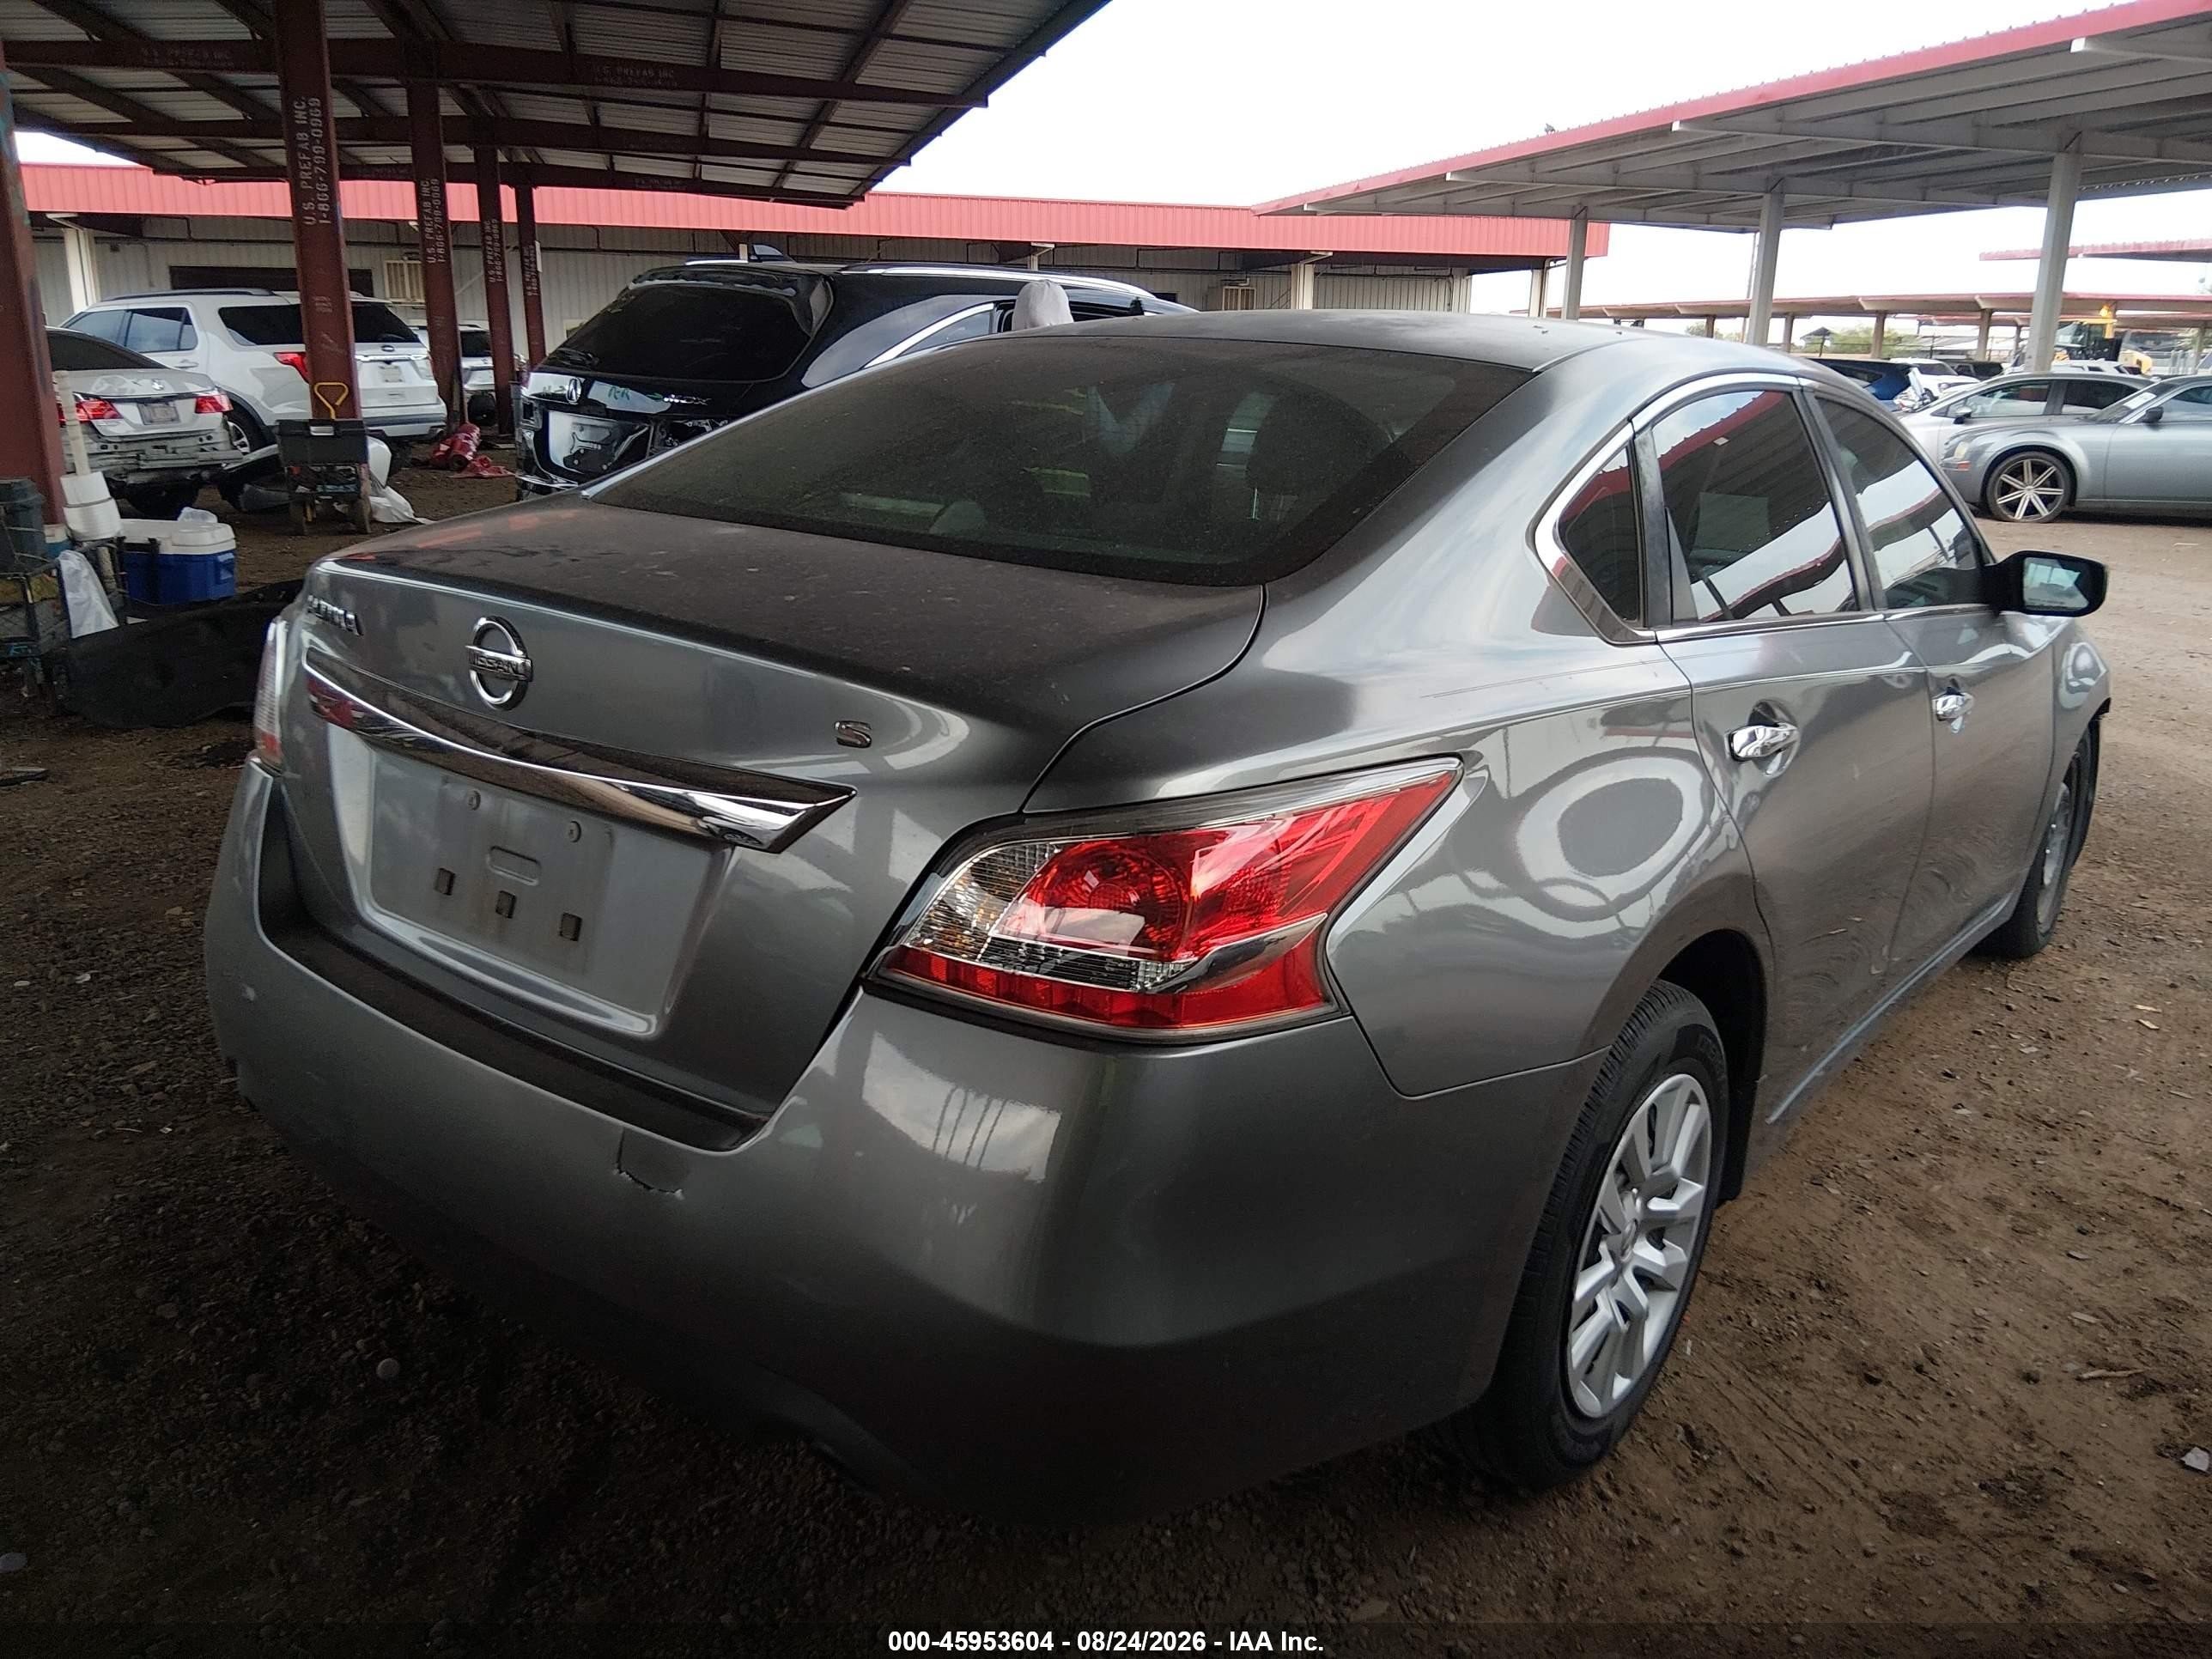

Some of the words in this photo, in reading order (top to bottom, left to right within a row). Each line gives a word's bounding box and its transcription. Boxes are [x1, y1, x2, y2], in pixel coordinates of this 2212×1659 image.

[293, 95, 308, 125] INC.
[295, 131, 314, 190] PREFAB
[301, 198, 317, 226] U.S.
[422, 202, 434, 240] PREFAB
[467, 649, 520, 676] NISSAN
[834, 720, 872, 749] S
